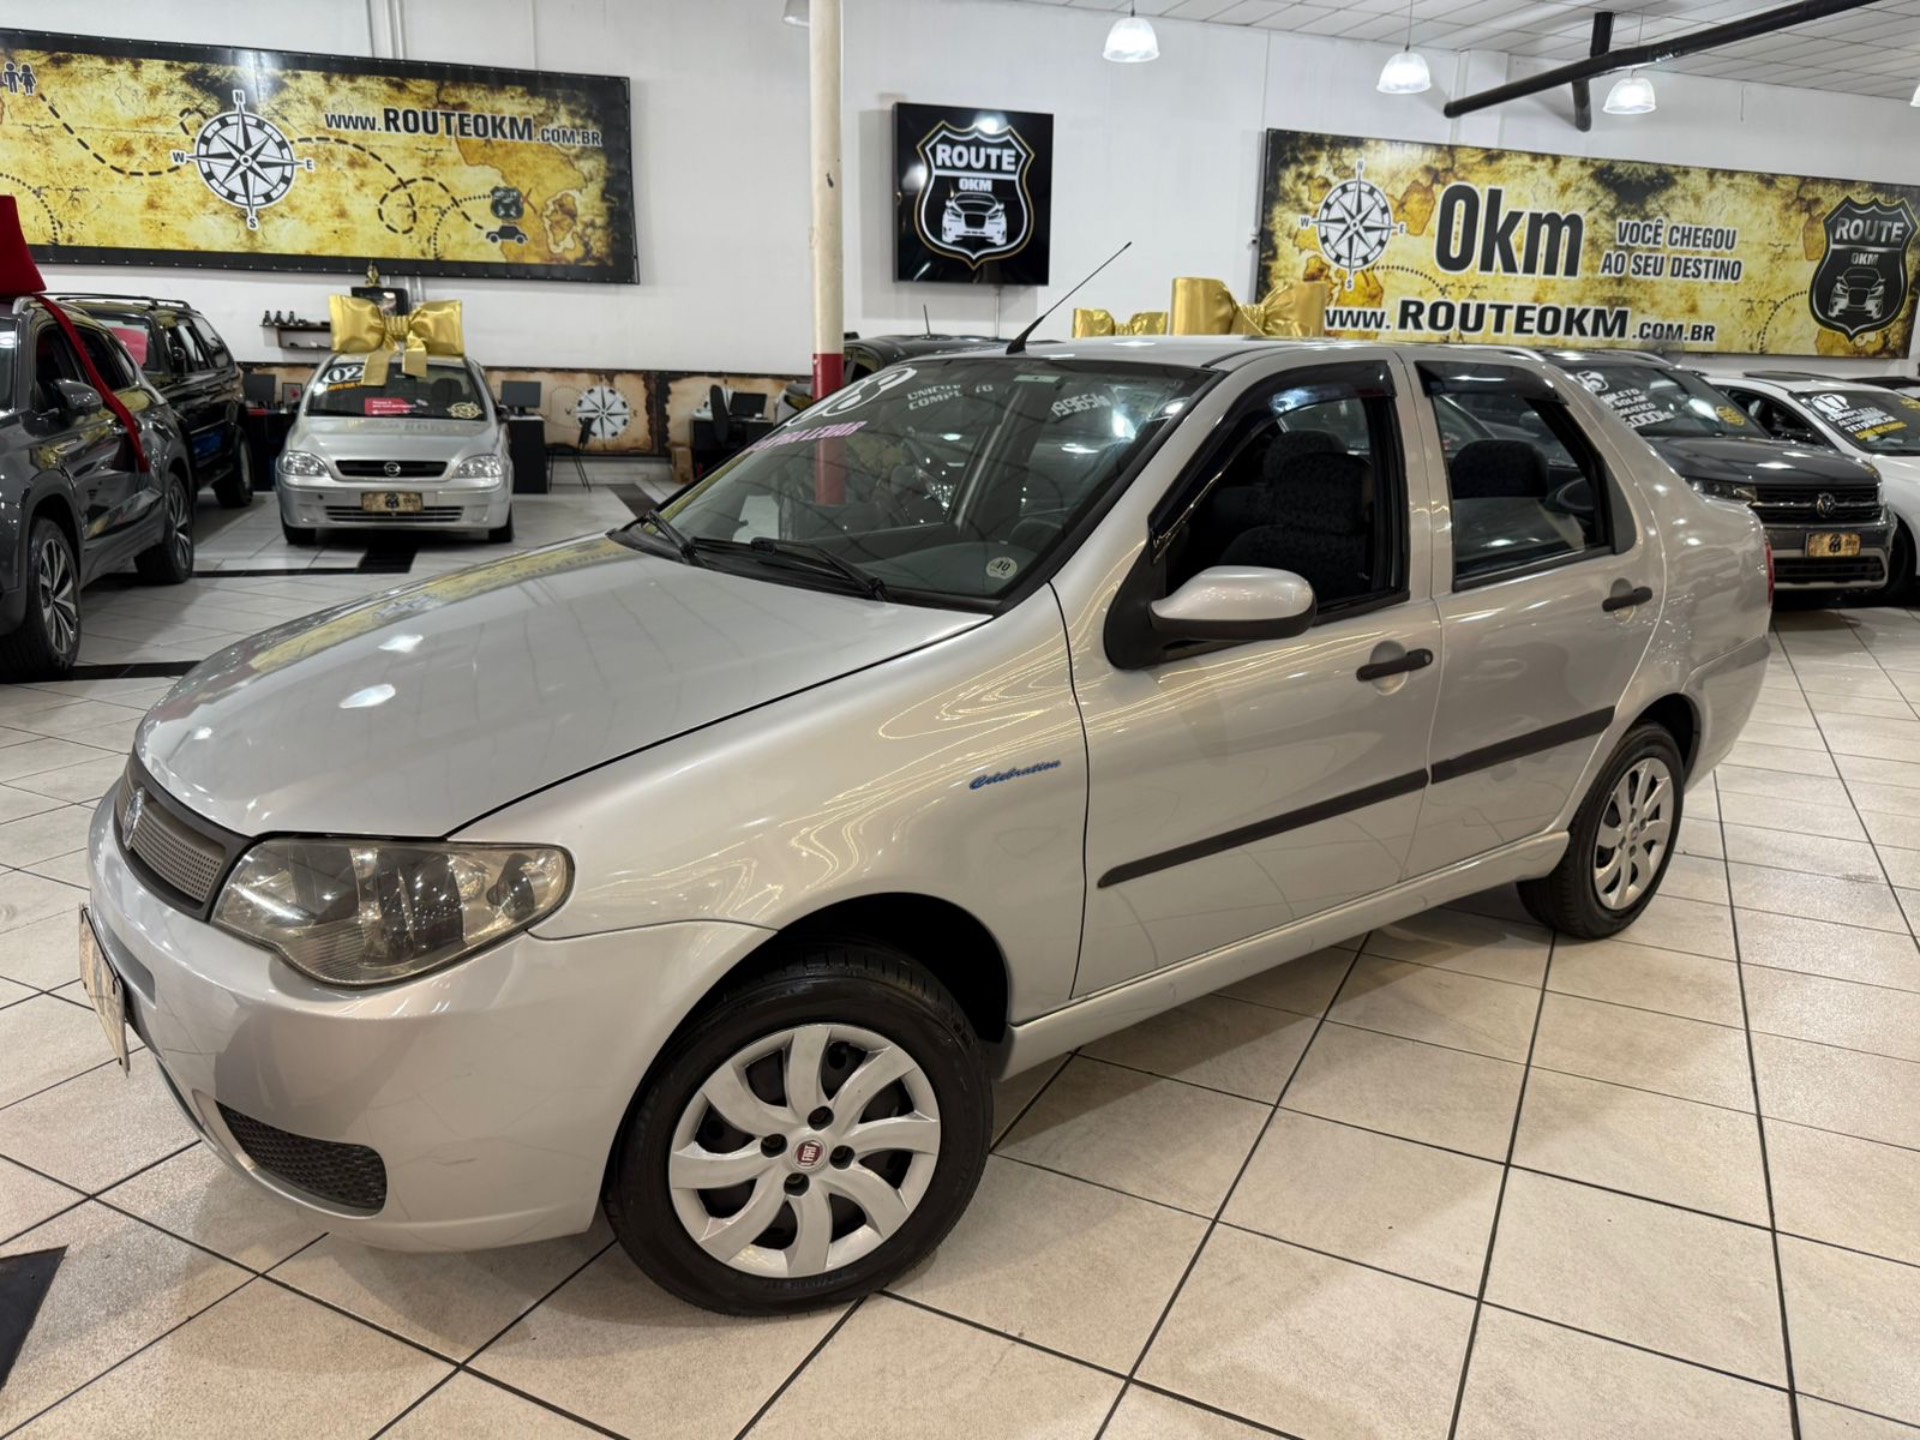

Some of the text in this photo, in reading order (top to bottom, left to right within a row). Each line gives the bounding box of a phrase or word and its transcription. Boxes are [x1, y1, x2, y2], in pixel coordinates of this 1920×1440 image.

[235, 91, 243, 102] N
[173, 152, 184, 163] W
[306, 160, 313, 169] E
[936, 144, 1016, 171] ROUTE
[249, 218, 257, 228] S
[1835, 217, 1905, 243] ROUTE
[1618, 219, 1737, 250] VOCÊ CHEGOU
[1600, 252, 1742, 281] AO SEU DESTINO
